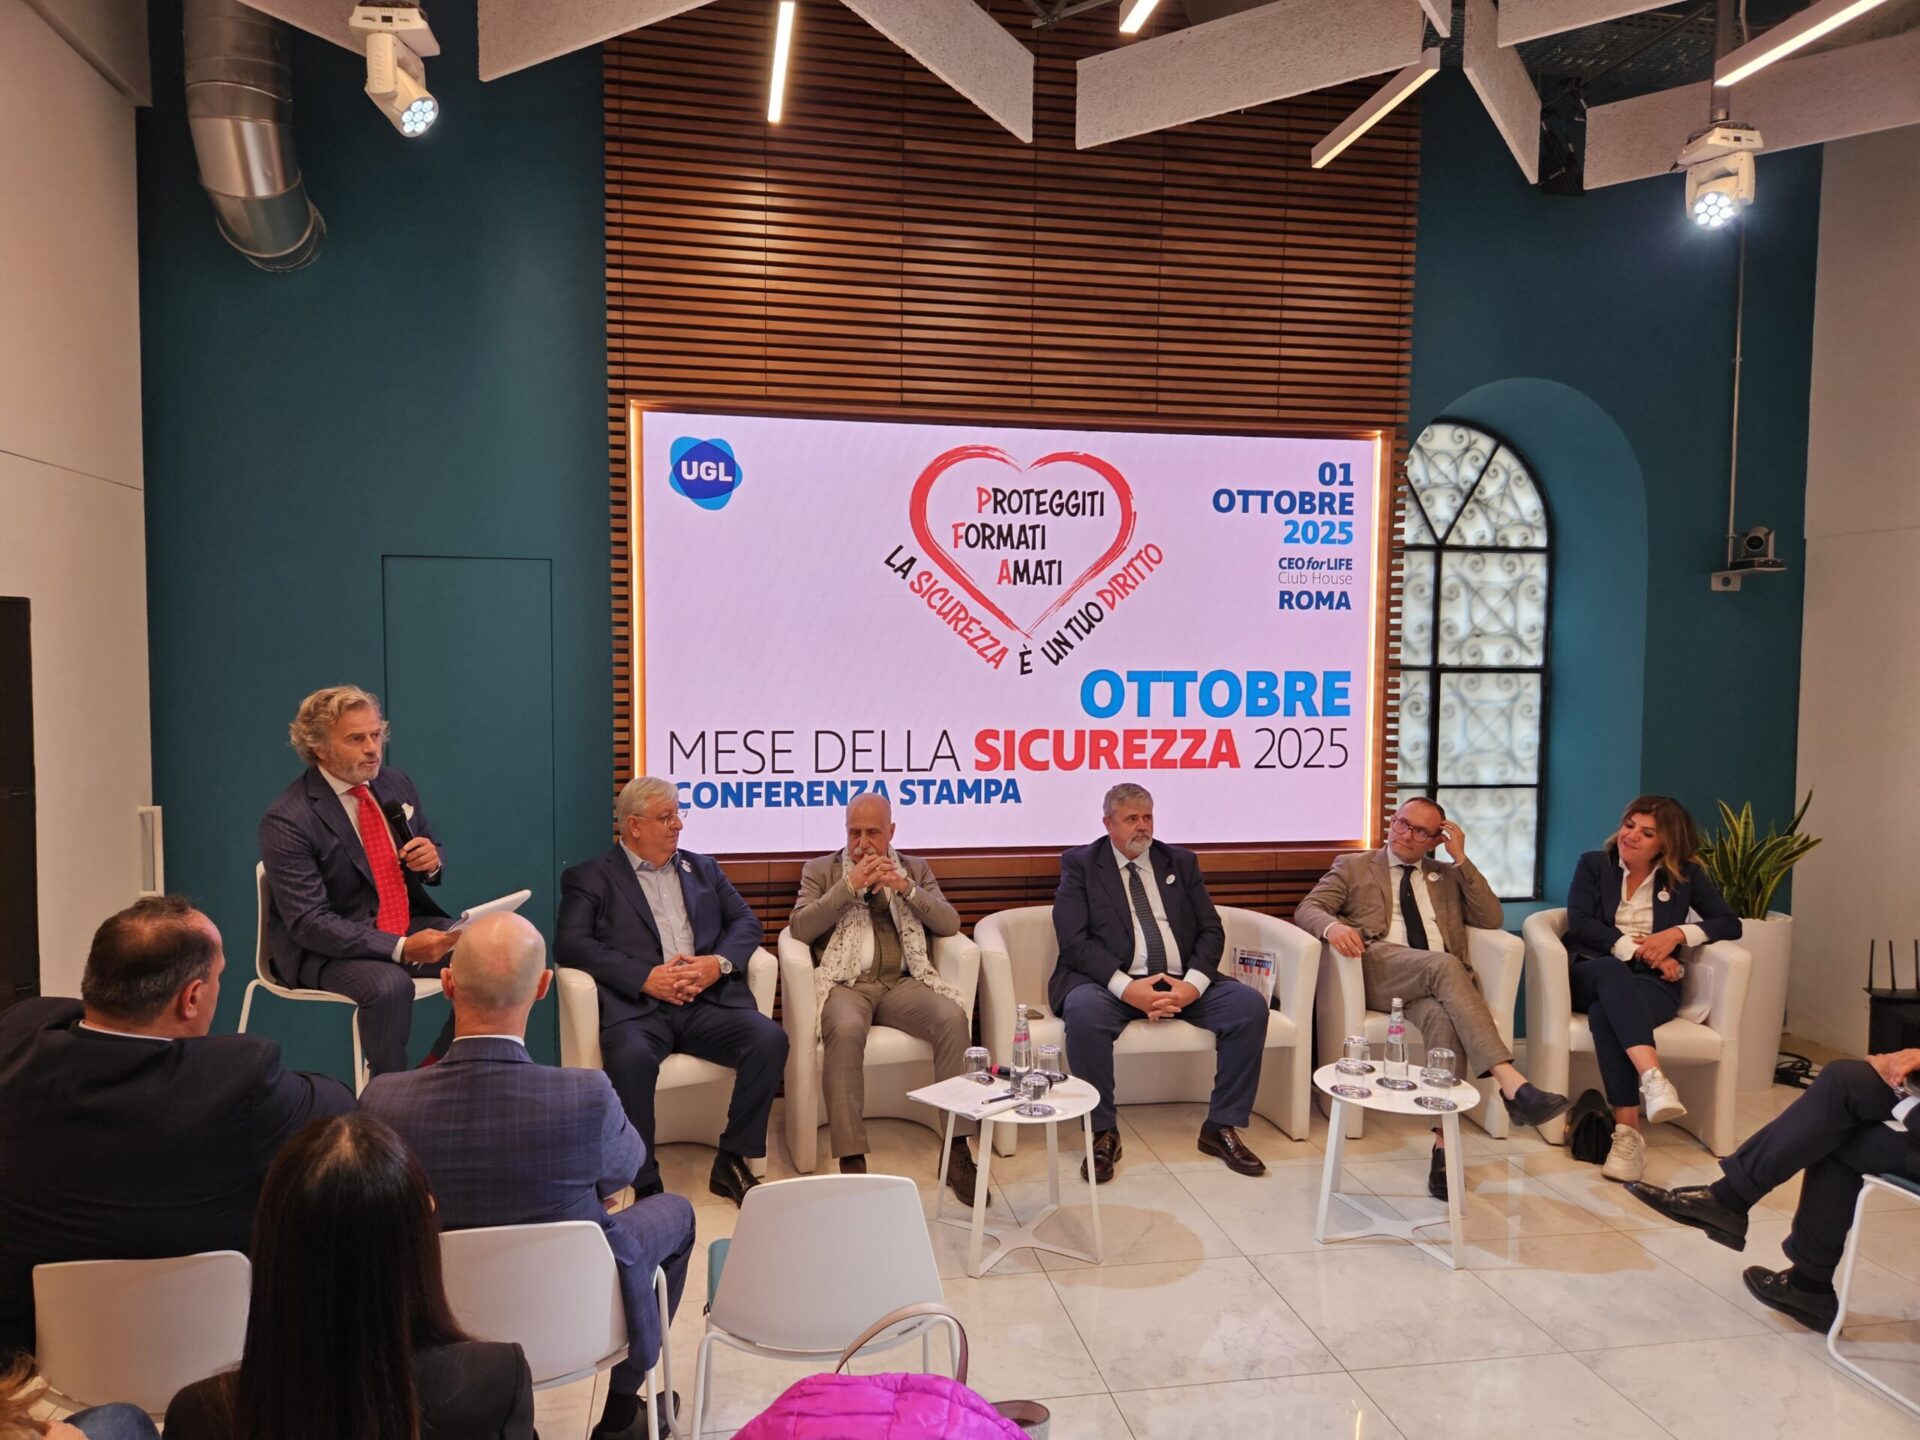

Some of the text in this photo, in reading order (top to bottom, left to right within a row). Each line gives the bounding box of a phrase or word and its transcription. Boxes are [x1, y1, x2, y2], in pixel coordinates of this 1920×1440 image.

[681, 460, 733, 482] UGL
[1318, 462, 1354, 486] 01
[977, 487, 1104, 517] PROTEGGITI
[1212, 488, 1354, 516] OTTOBRE
[952, 522, 1046, 550] FORMATI
[1283, 519, 1353, 545] 2025
[997, 559, 1062, 586] AMATI
[1278, 571, 1352, 585] Club House
[884, 543, 1163, 675] LA SICUREZZA È UN TUO DIRITTO
[1279, 591, 1351, 610] ROMA
[1080, 669, 1350, 719] OTTOBRE
[670, 728, 1348, 775] MESE DELLA SICUREZZA 2025
[899, 778, 1022, 805] STAMPA
